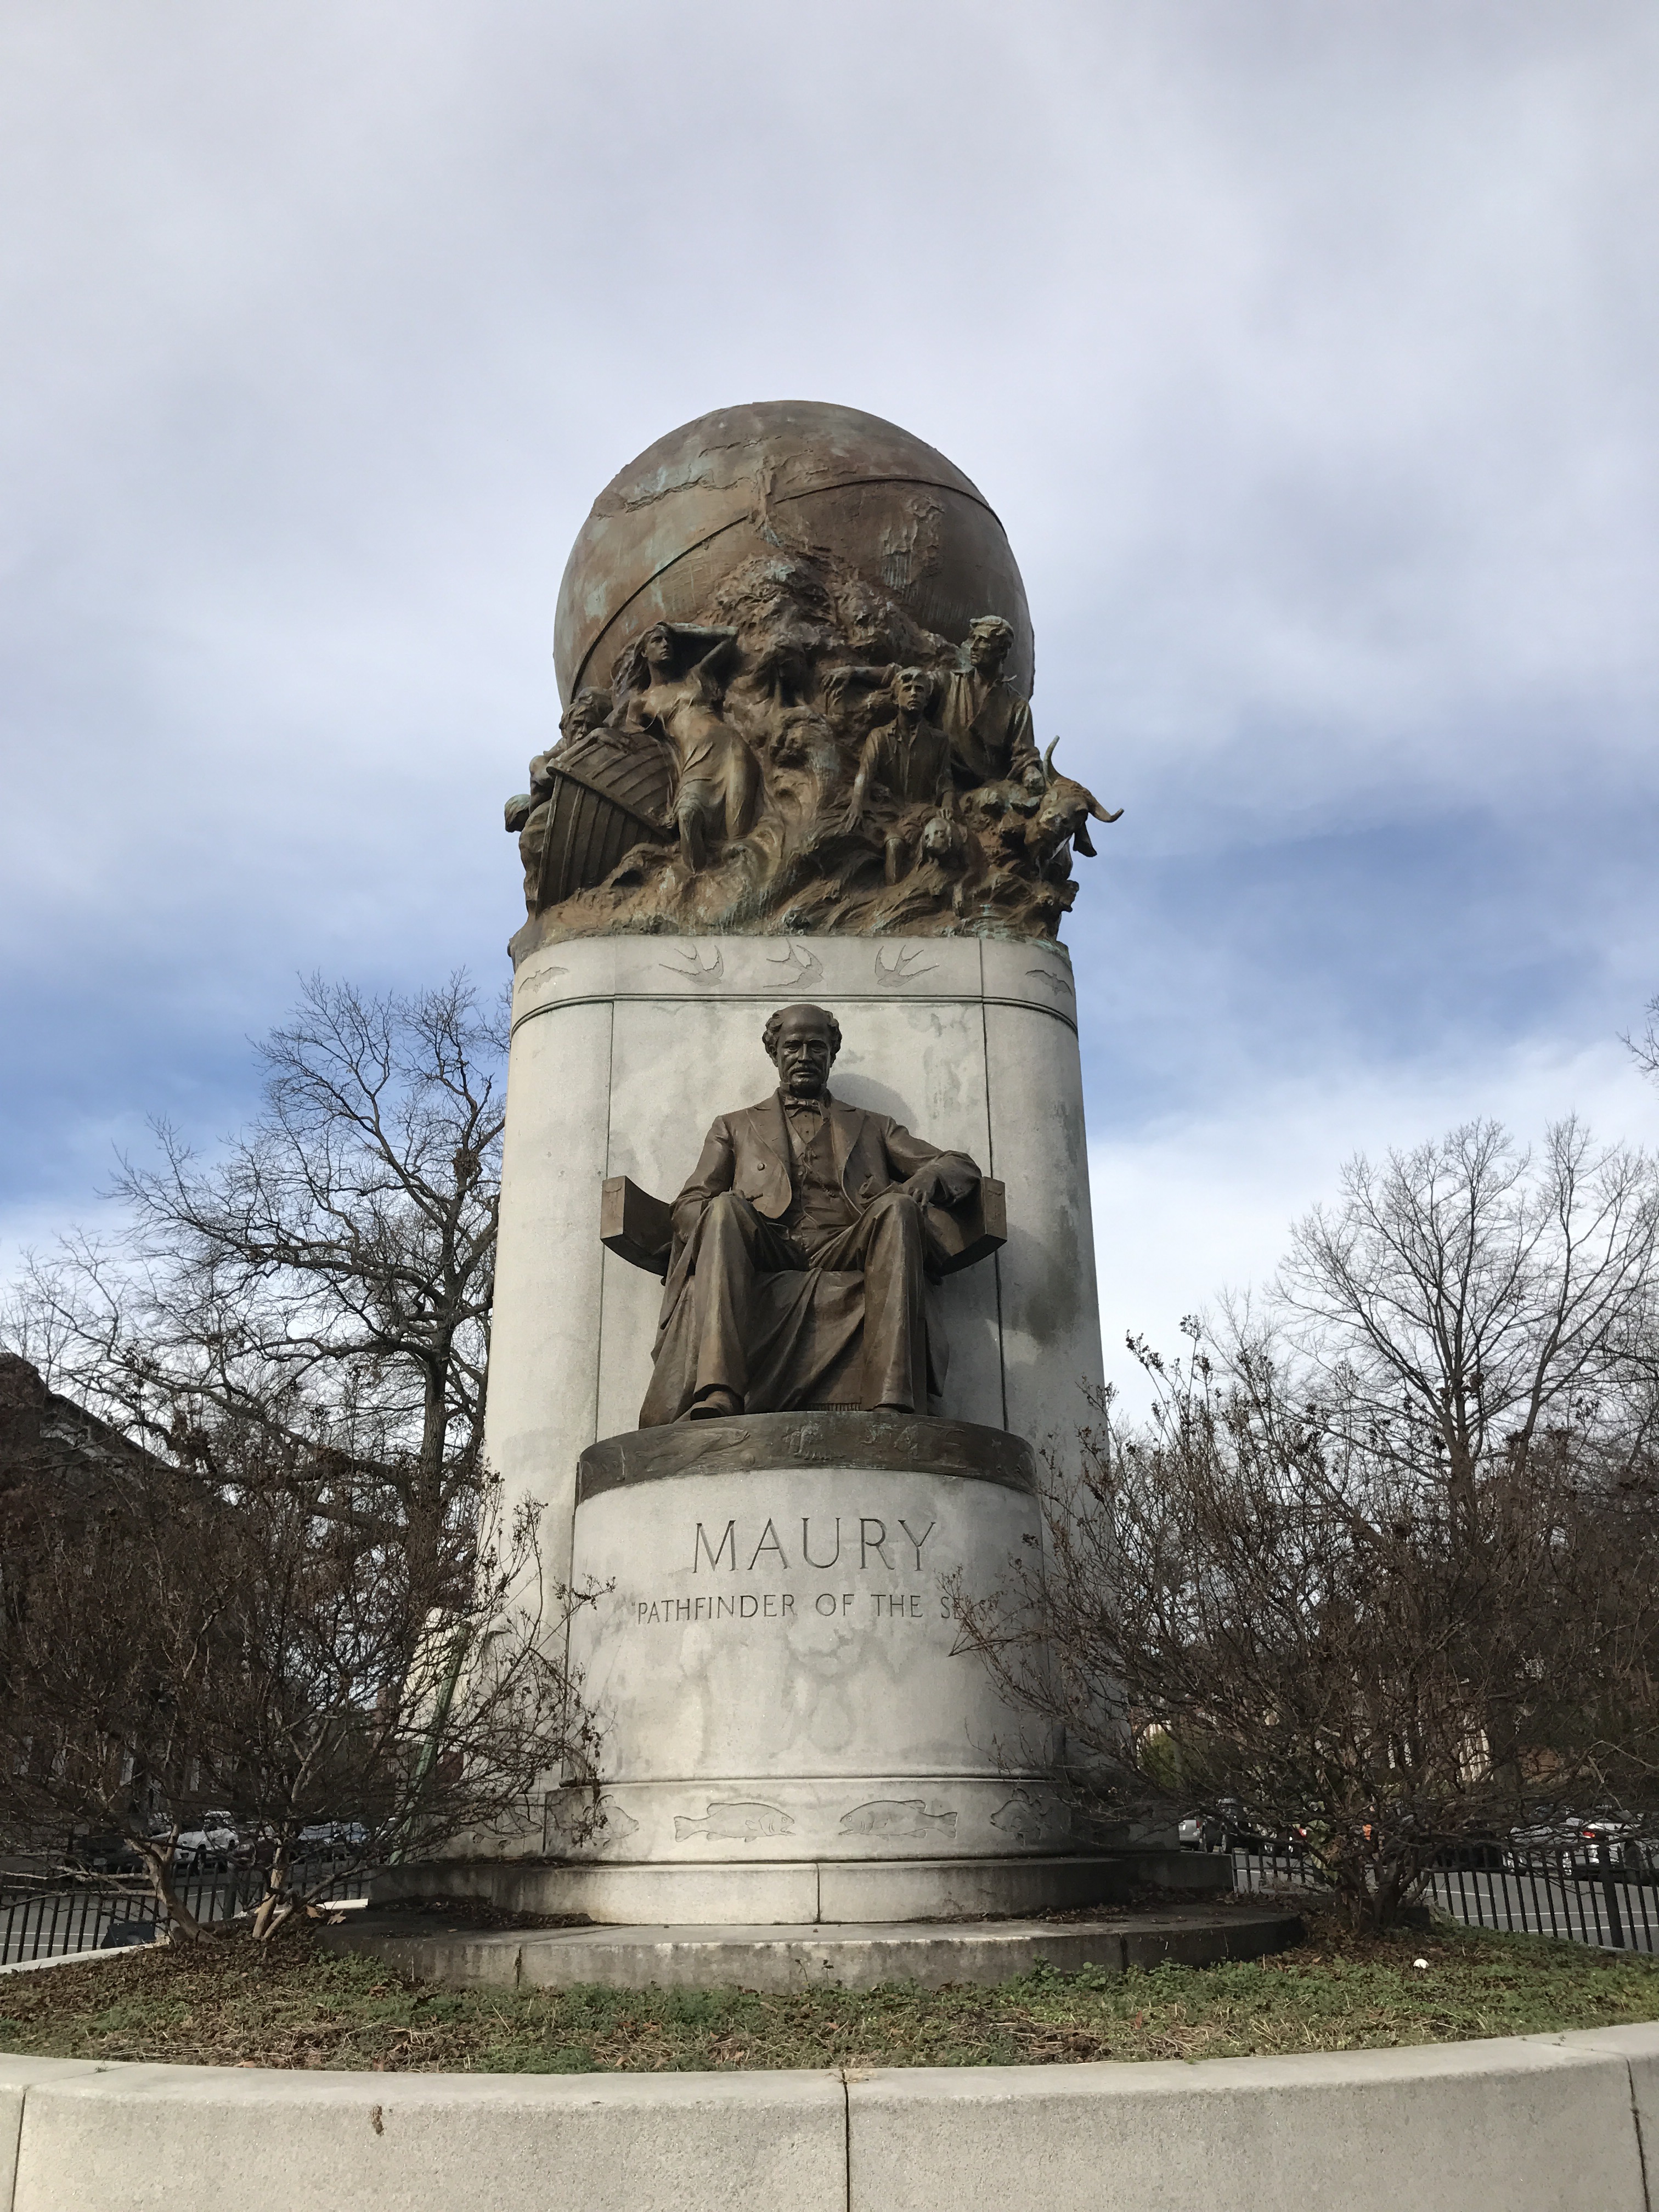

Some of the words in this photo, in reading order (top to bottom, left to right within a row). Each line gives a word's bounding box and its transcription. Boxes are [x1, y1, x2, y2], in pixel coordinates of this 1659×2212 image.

[693, 1517, 936, 1573] MAURY
[815, 1593, 854, 1616] OF
[871, 1594, 923, 1617] THE
